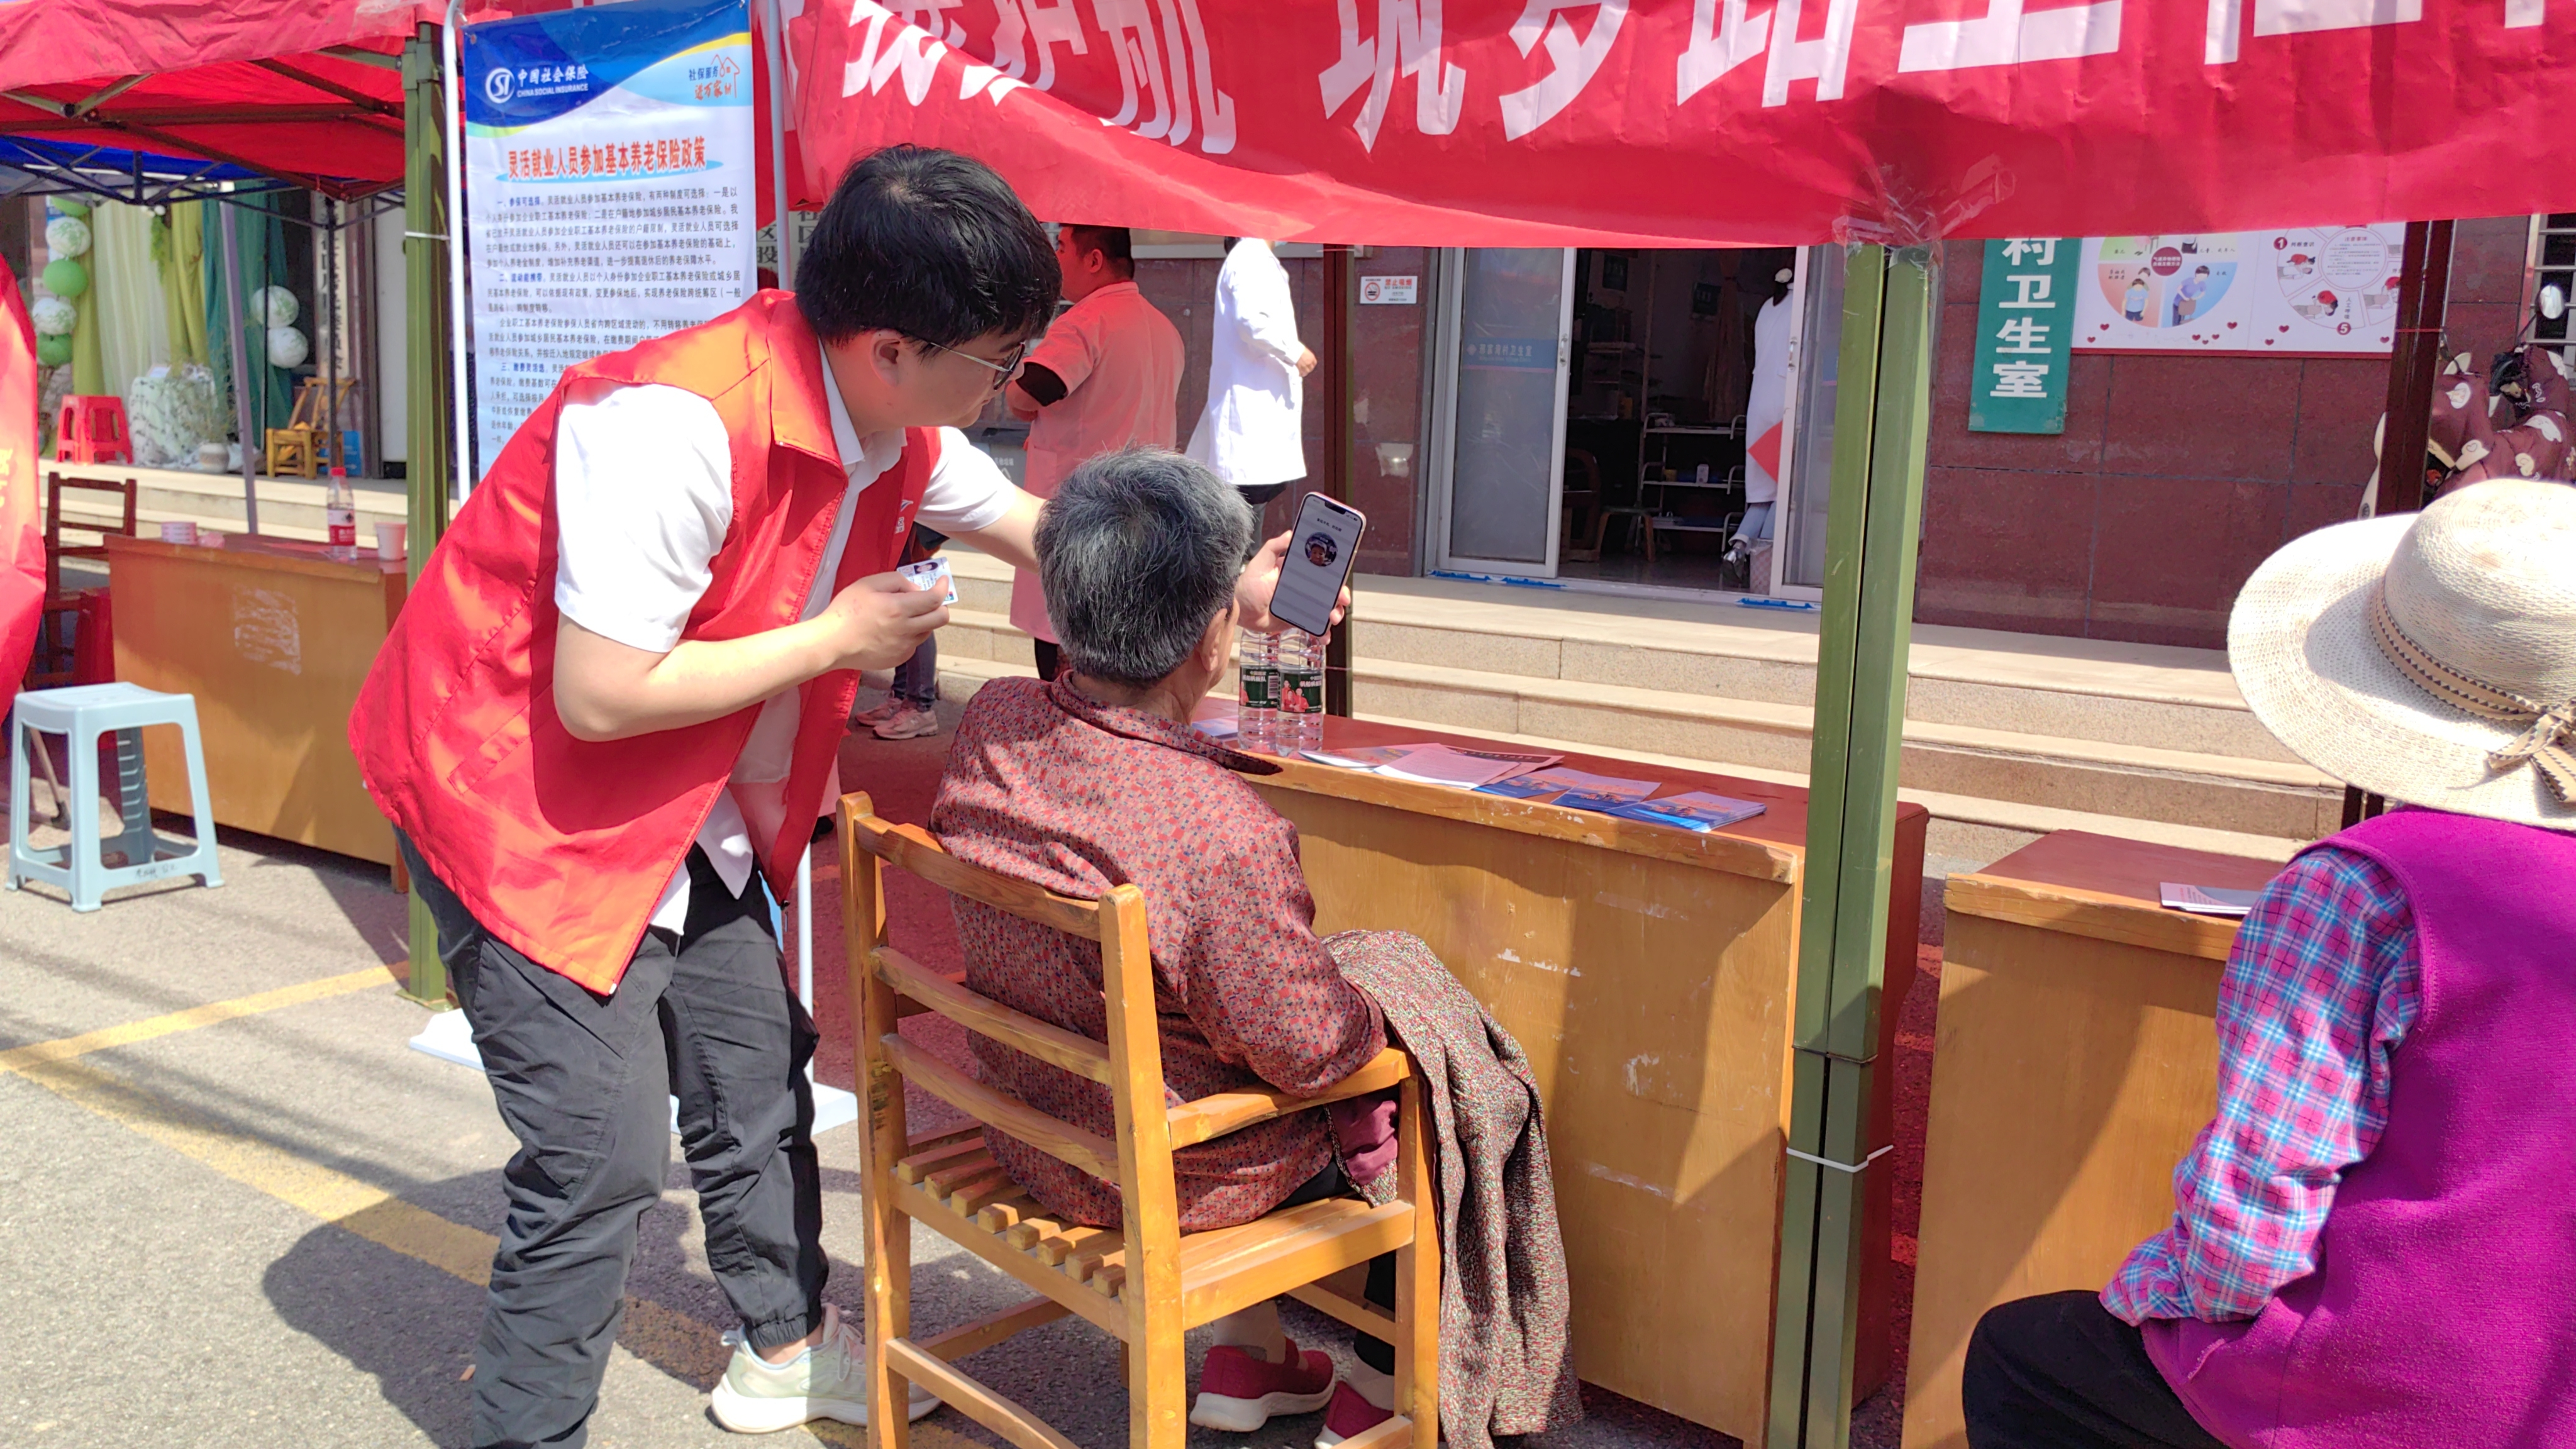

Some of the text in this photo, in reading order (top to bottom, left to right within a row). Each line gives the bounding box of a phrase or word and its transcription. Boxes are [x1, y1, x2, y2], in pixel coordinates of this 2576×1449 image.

[518, 64, 589, 87] 中国社会保险
[689, 66, 718, 81] 社保服务
[517, 83, 589, 97] CHINA SOCIAL INSURANCE
[508, 136, 706, 179] 灵活就业人员参加基本养老保险政策
[1989, 237, 2062, 397] 村卫生室
